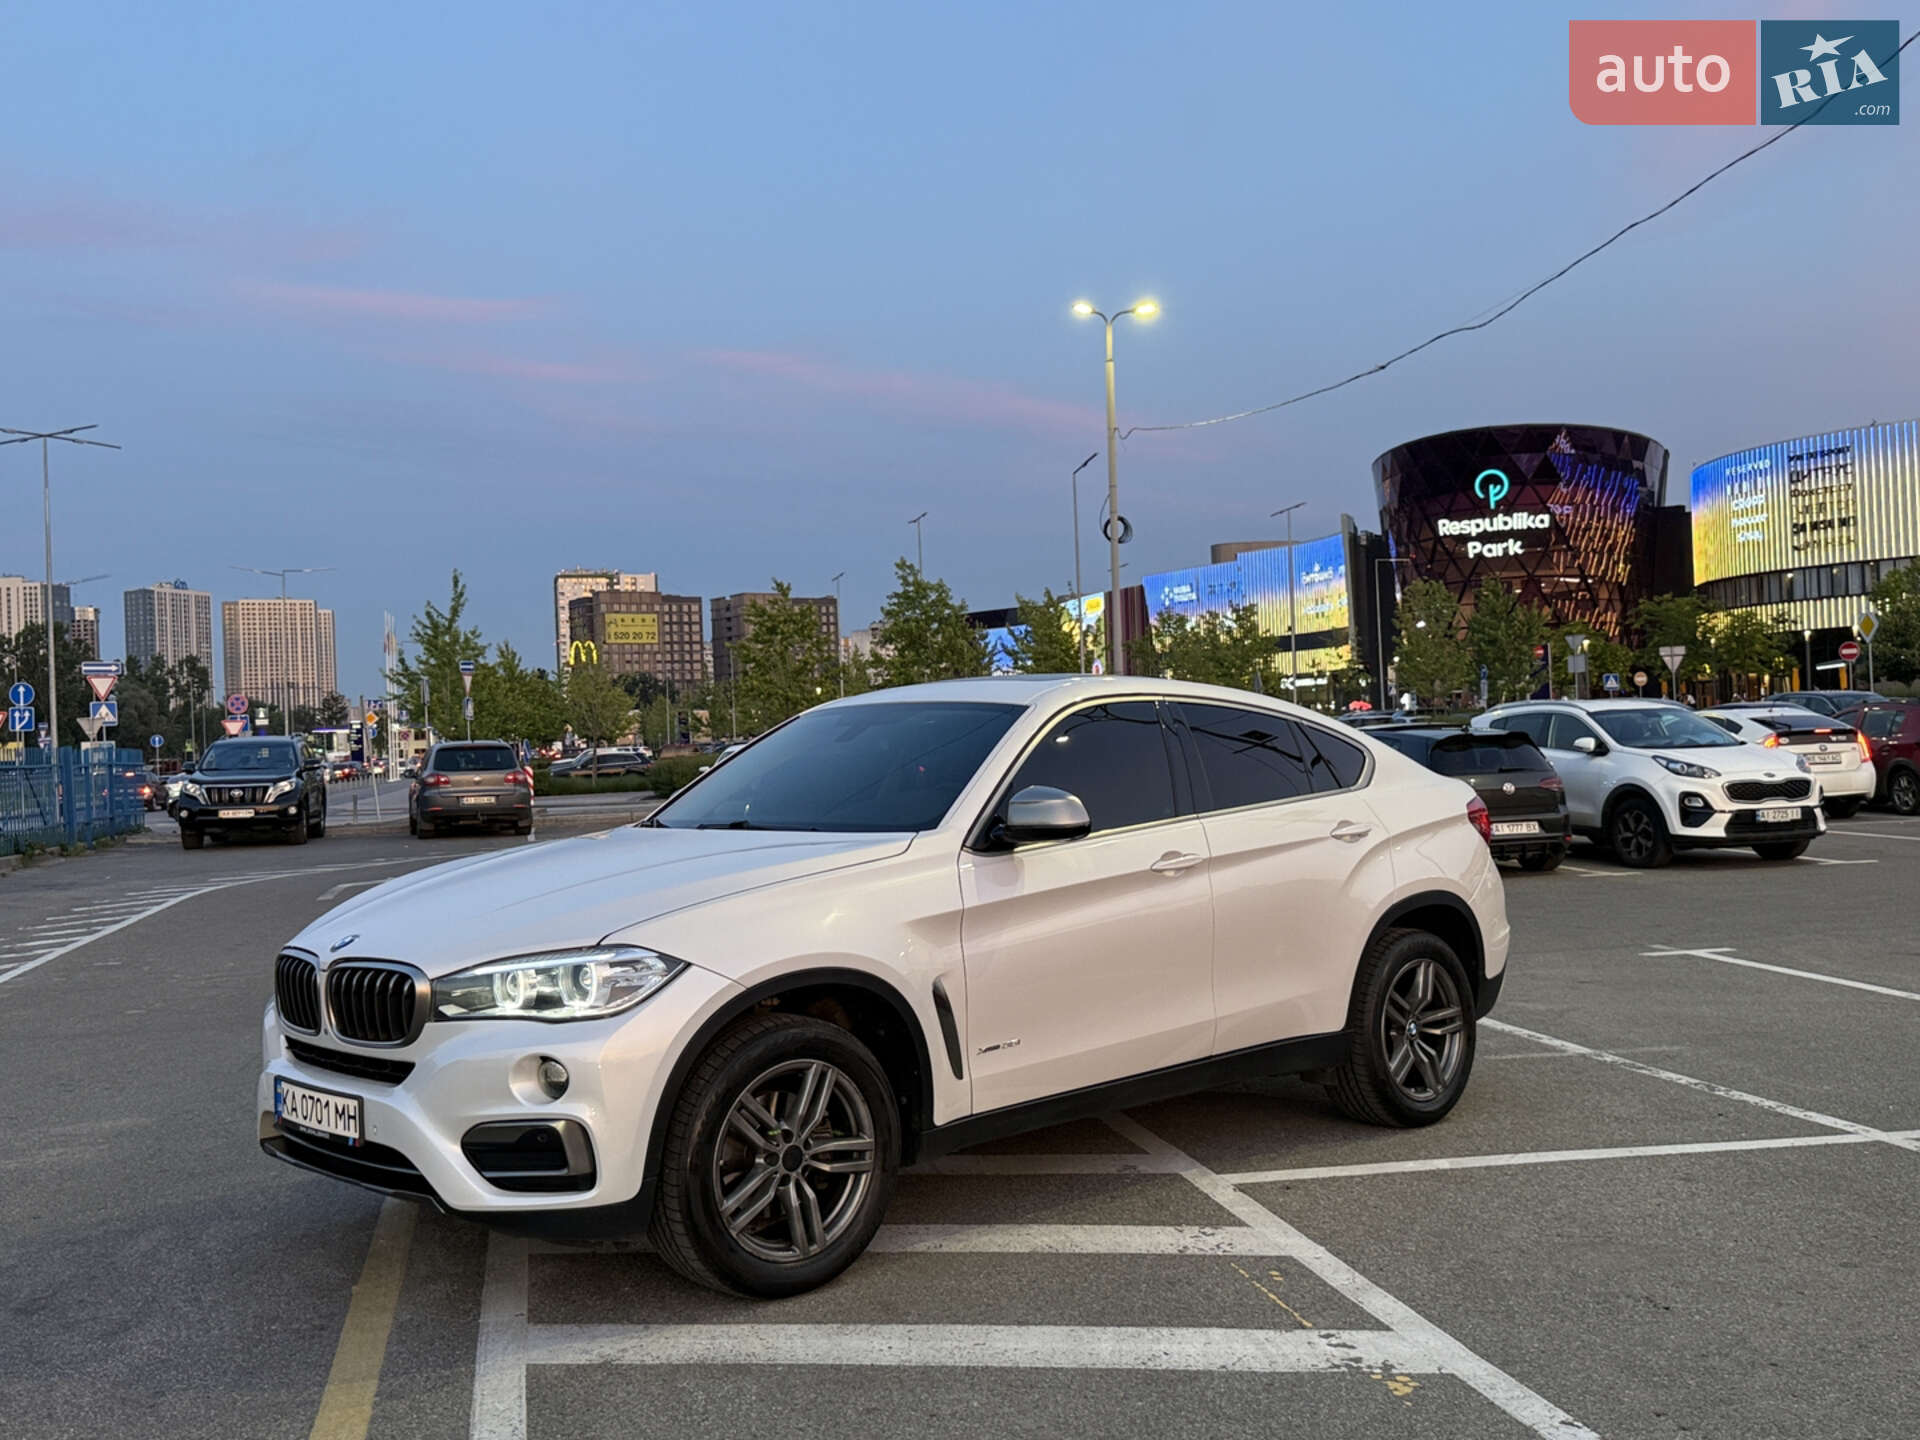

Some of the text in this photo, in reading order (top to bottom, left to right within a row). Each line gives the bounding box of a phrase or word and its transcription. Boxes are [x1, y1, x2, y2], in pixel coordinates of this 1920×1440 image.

[1437, 512, 1550, 537] Respublika
[1467, 538, 1525, 559] Park
[614, 631, 630, 640] 520
[632, 631, 643, 640] 20
[645, 631, 657, 640] 72
[282, 1088, 298, 1118] KA
[301, 1093, 330, 1127] 0701
[335, 1101, 357, 1133] MH
